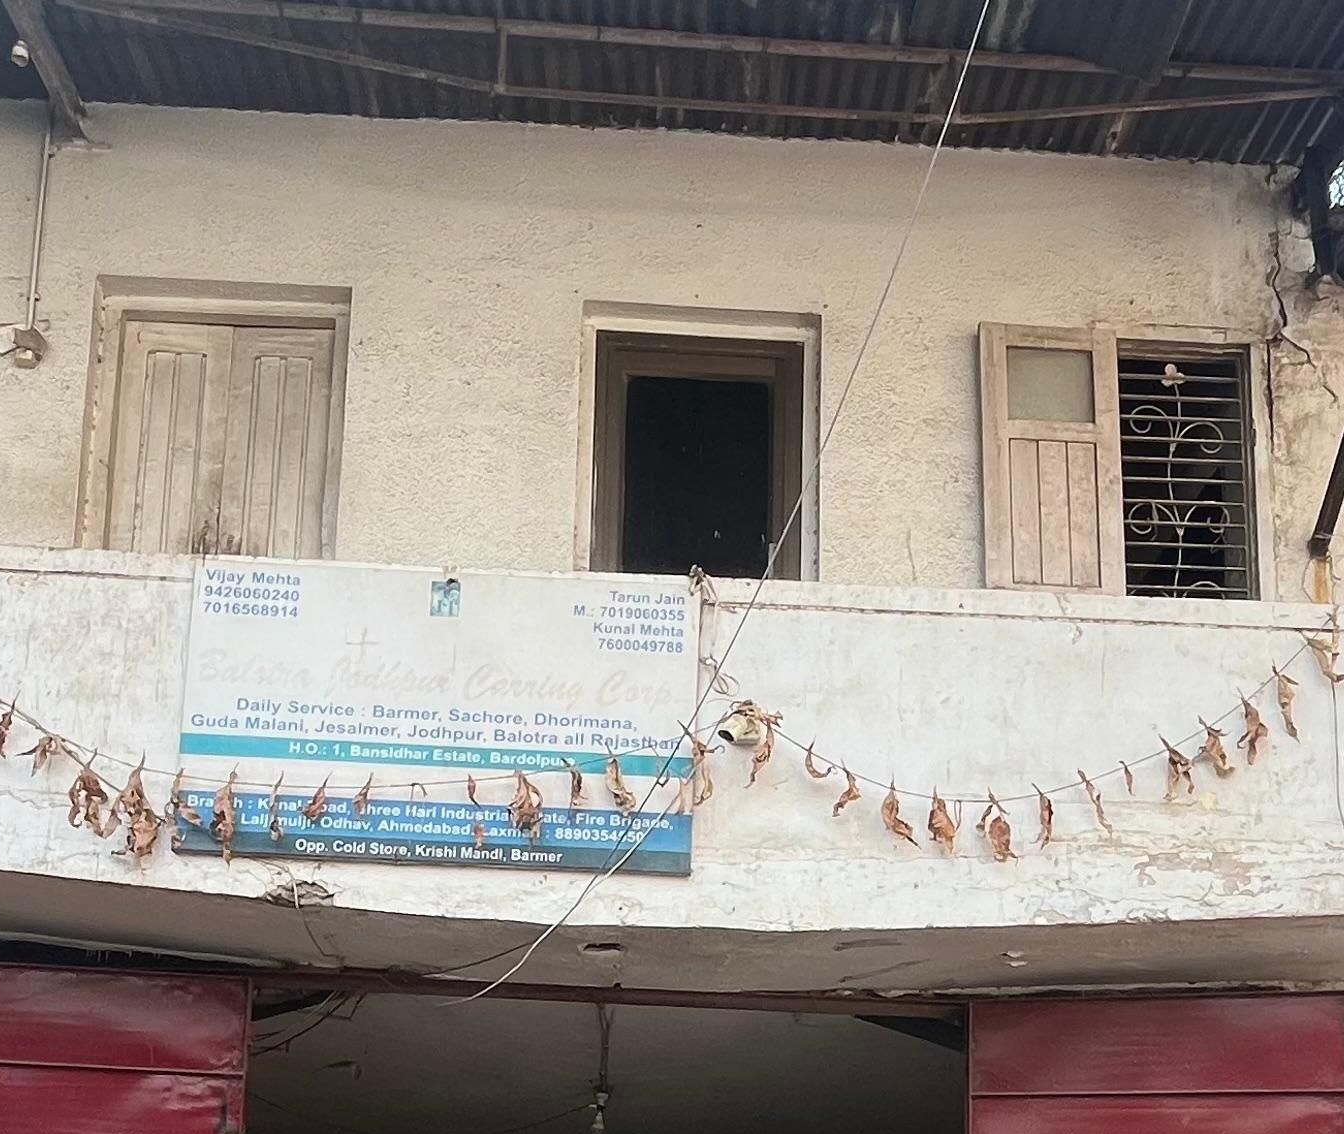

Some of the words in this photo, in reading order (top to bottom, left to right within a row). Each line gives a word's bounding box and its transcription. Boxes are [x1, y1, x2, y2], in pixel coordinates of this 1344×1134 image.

[205, 569, 246, 585] Vijay
[252, 571, 301, 586] Mehta
[204, 585, 300, 602] 9426060240
[609, 591, 650, 604] Tarun
[654, 593, 685, 605] Jain
[203, 601, 299, 618] 7016568914
[600, 606, 685, 621] 7019060355
[593, 622, 635, 635] Kunal
[640, 624, 684, 637] Mehta
[598, 638, 684, 653] 7600049788
[236, 697, 281, 715] Daily
[288, 700, 355, 717] Service
[372, 705, 442, 722] Barmer,
[449, 709, 528, 727] Sachore,
[535, 713, 638, 732] Dhorimana,
[191, 714, 239, 729] Guda
[245, 717, 309, 734] Malani,
[315, 721, 401, 738] Jesalmer,
[408, 725, 487, 743] Jodhpur,
[494, 729, 559, 745] Balotra
[564, 732, 584, 746] all
[350, 745, 430, 761] Bansidhar
[433, 749, 485, 765] Estate,
[187, 794, 243, 809] Brah
[258, 798, 301, 812] Knal
[405, 805, 437, 818] Hari
[441, 807, 513, 822] Industria
[576, 812, 605, 826] Fire
[320, 816, 373, 832] Odhav,
[295, 838, 329, 854] Opp.
[333, 840, 366, 854] Cold
[369, 842, 411, 858] Store,
[415, 844, 457, 859] Krishi
[460, 846, 507, 862] Mandi,
[510, 848, 564, 864] Barmer
